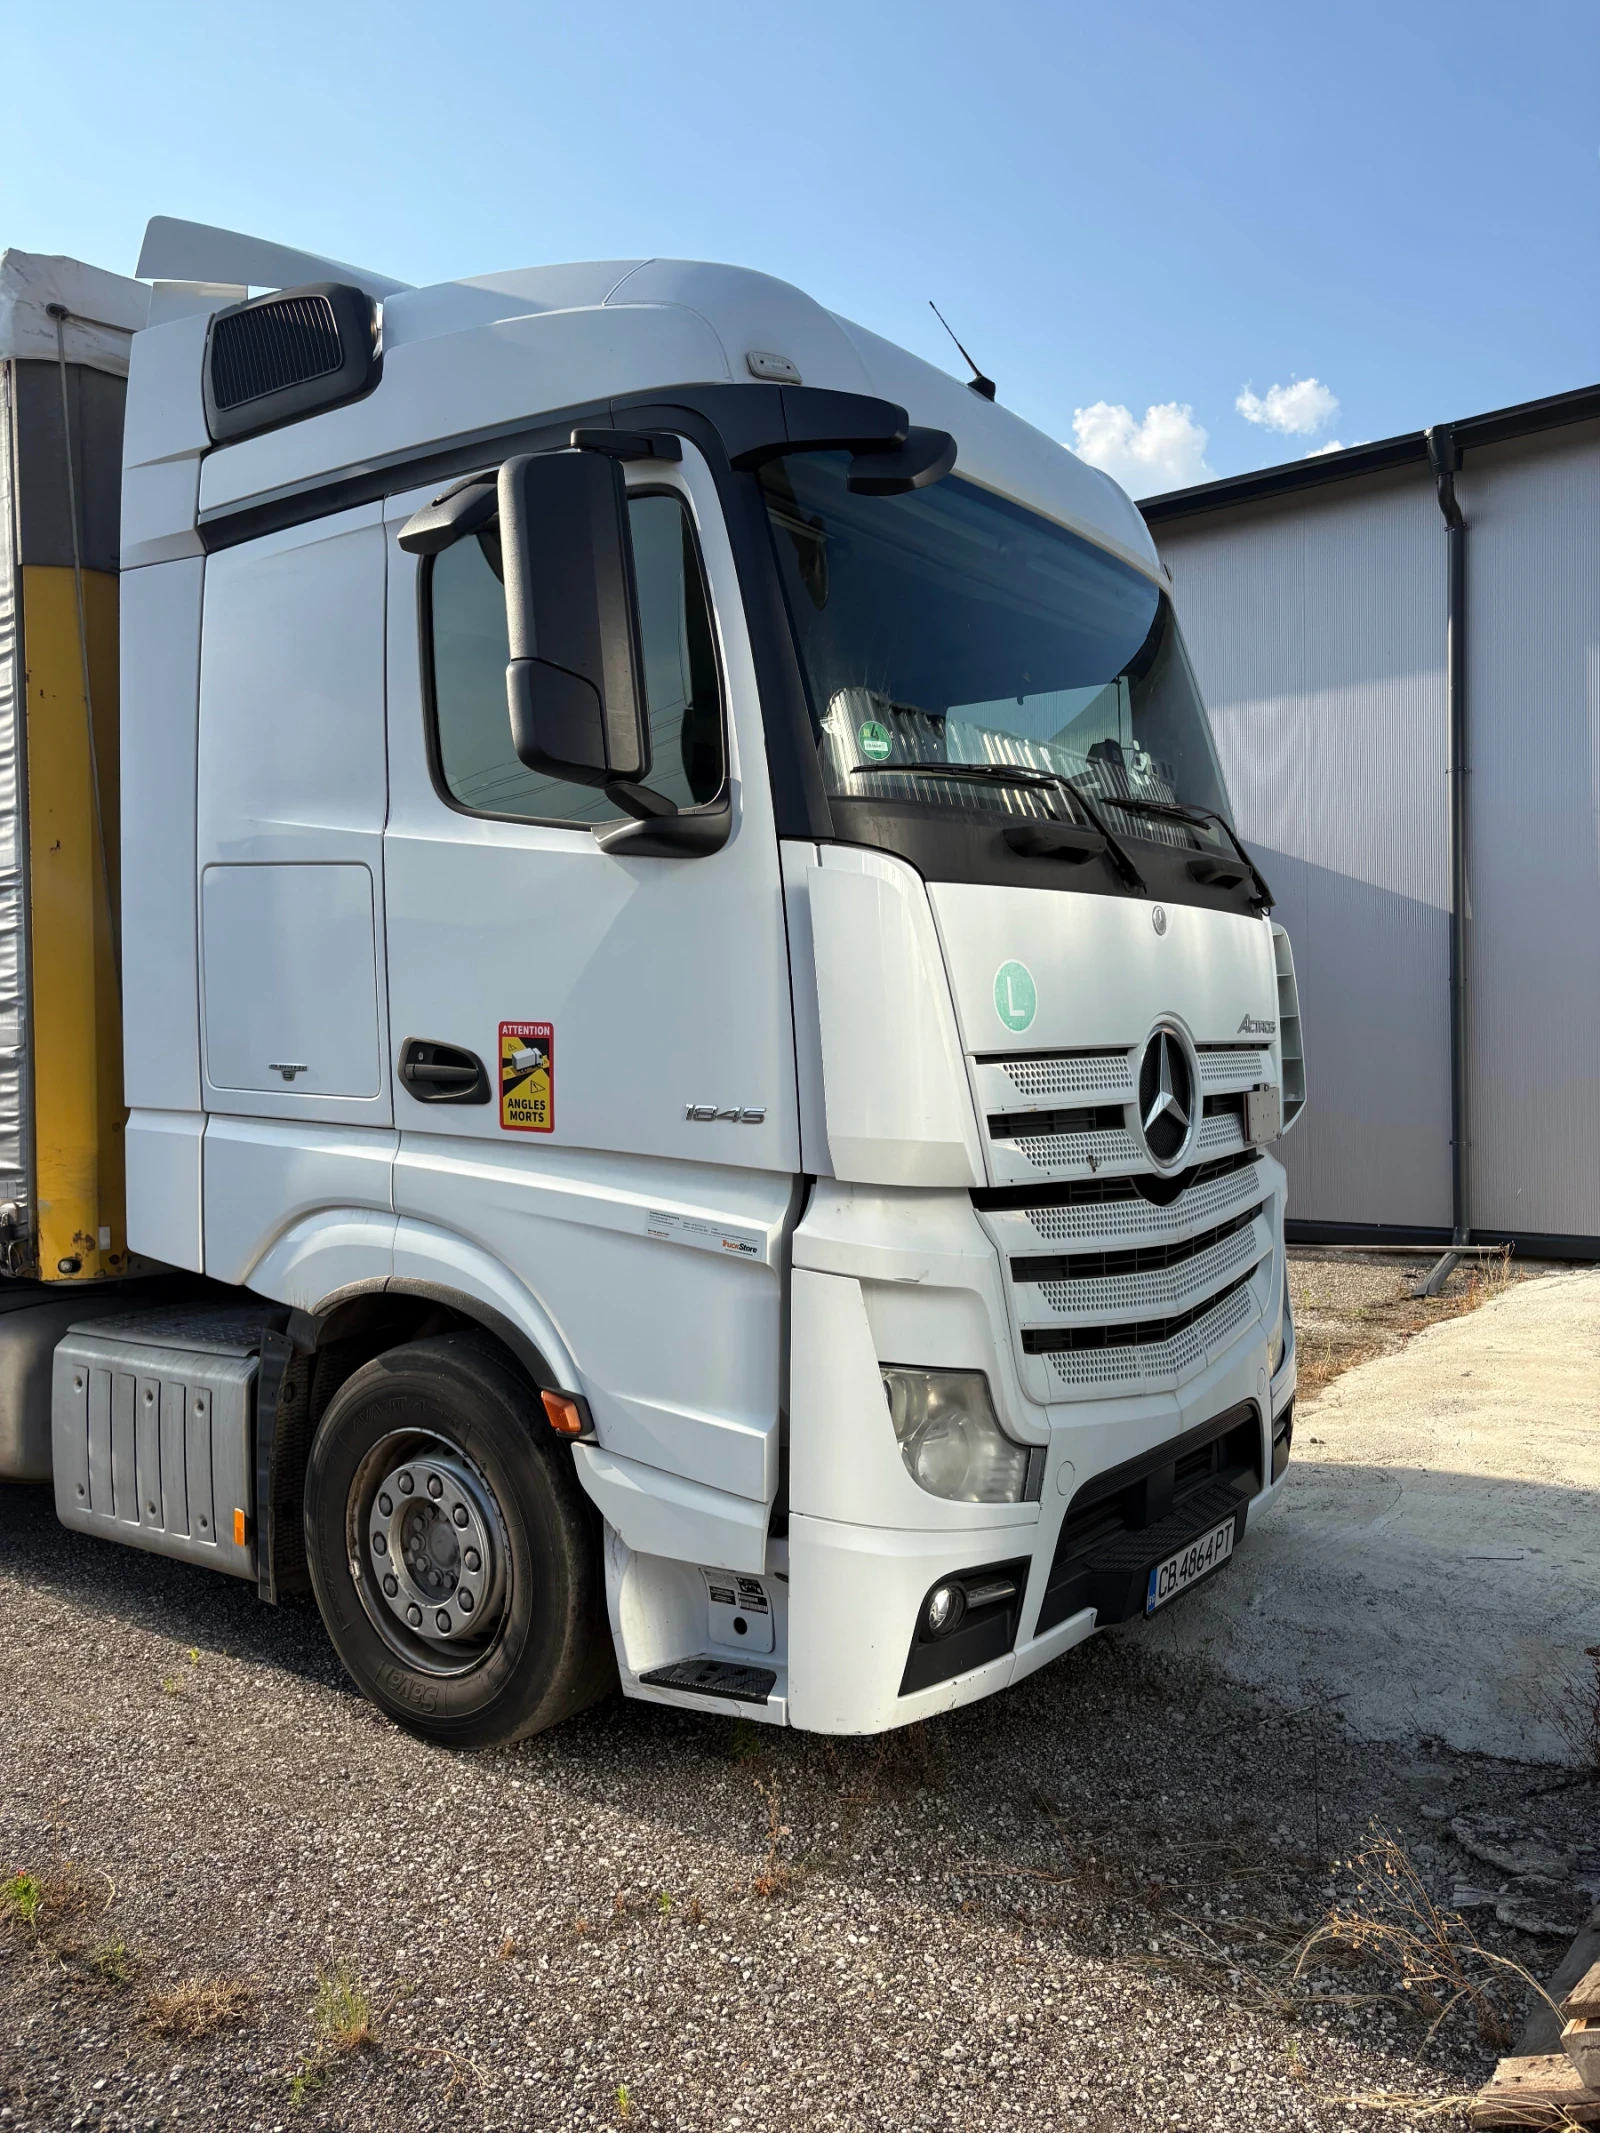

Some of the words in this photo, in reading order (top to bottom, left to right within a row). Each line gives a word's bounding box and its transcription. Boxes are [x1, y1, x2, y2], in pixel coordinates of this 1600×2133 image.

[1006, 976, 1025, 1016] L
[502, 1025, 550, 1036] ATTENTION
[507, 1098, 546, 1111] ANGLES
[509, 1109, 545, 1123] MORTS
[685, 1103, 767, 1125] 1845
